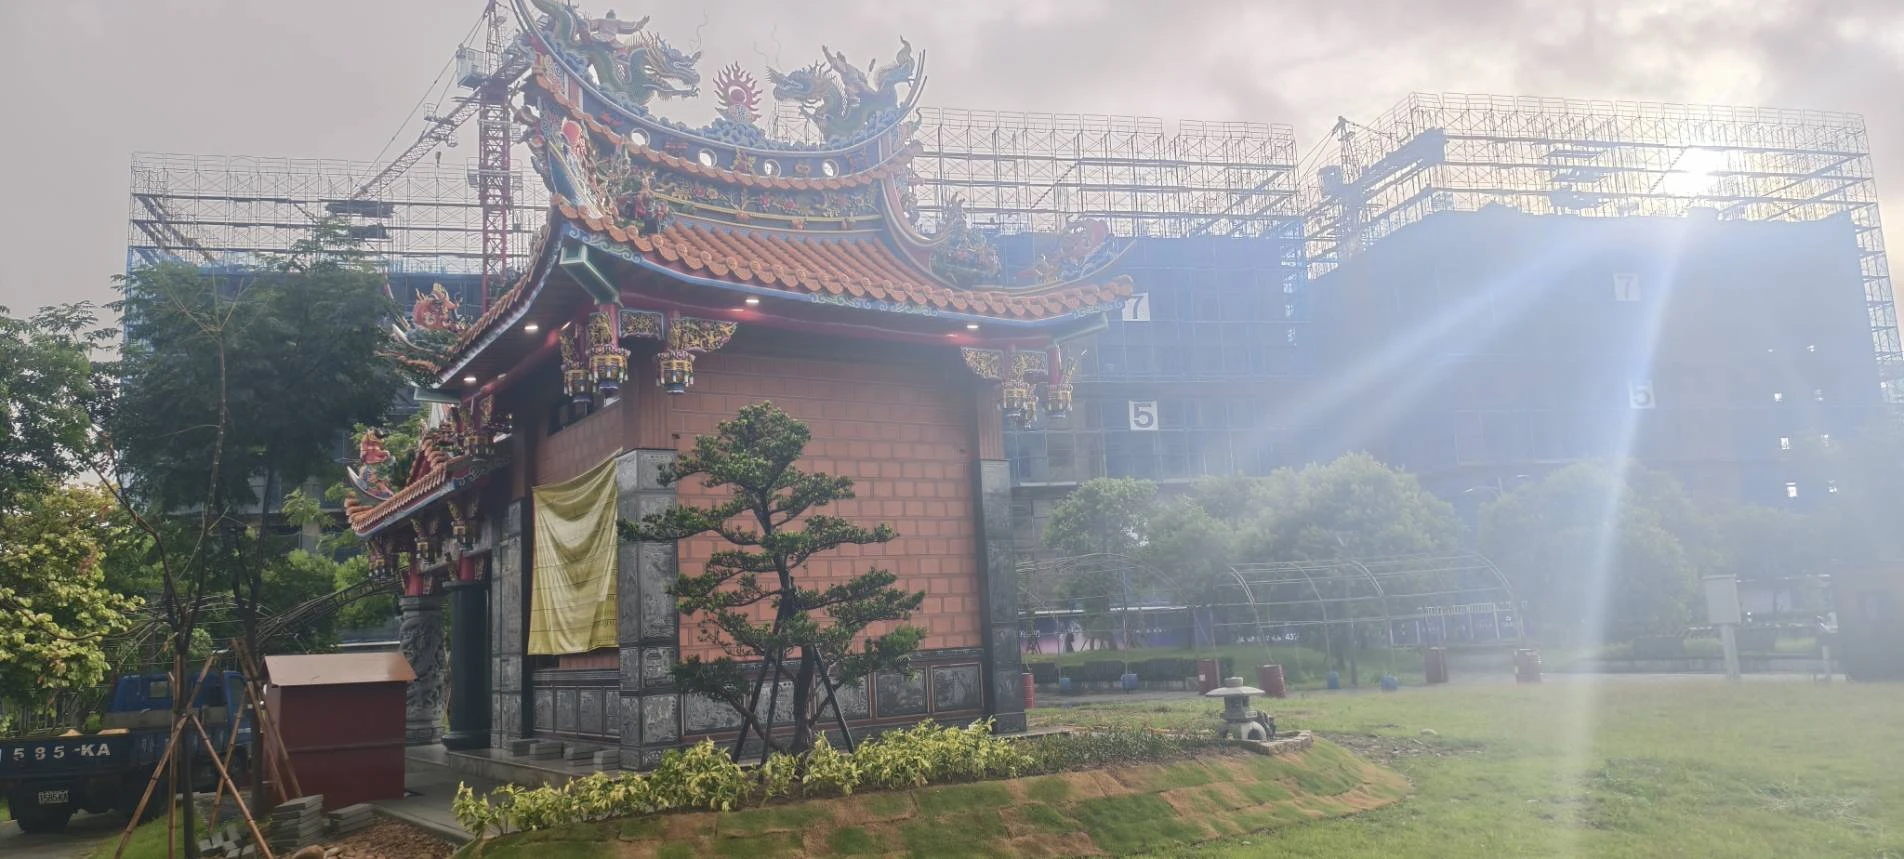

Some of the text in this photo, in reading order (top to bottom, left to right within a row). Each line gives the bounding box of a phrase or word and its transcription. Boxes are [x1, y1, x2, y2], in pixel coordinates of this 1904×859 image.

[1617, 276, 1635, 300] 7
[1130, 295, 1144, 320] 7
[1633, 384, 1651, 405] 5
[1133, 403, 1154, 428] 5
